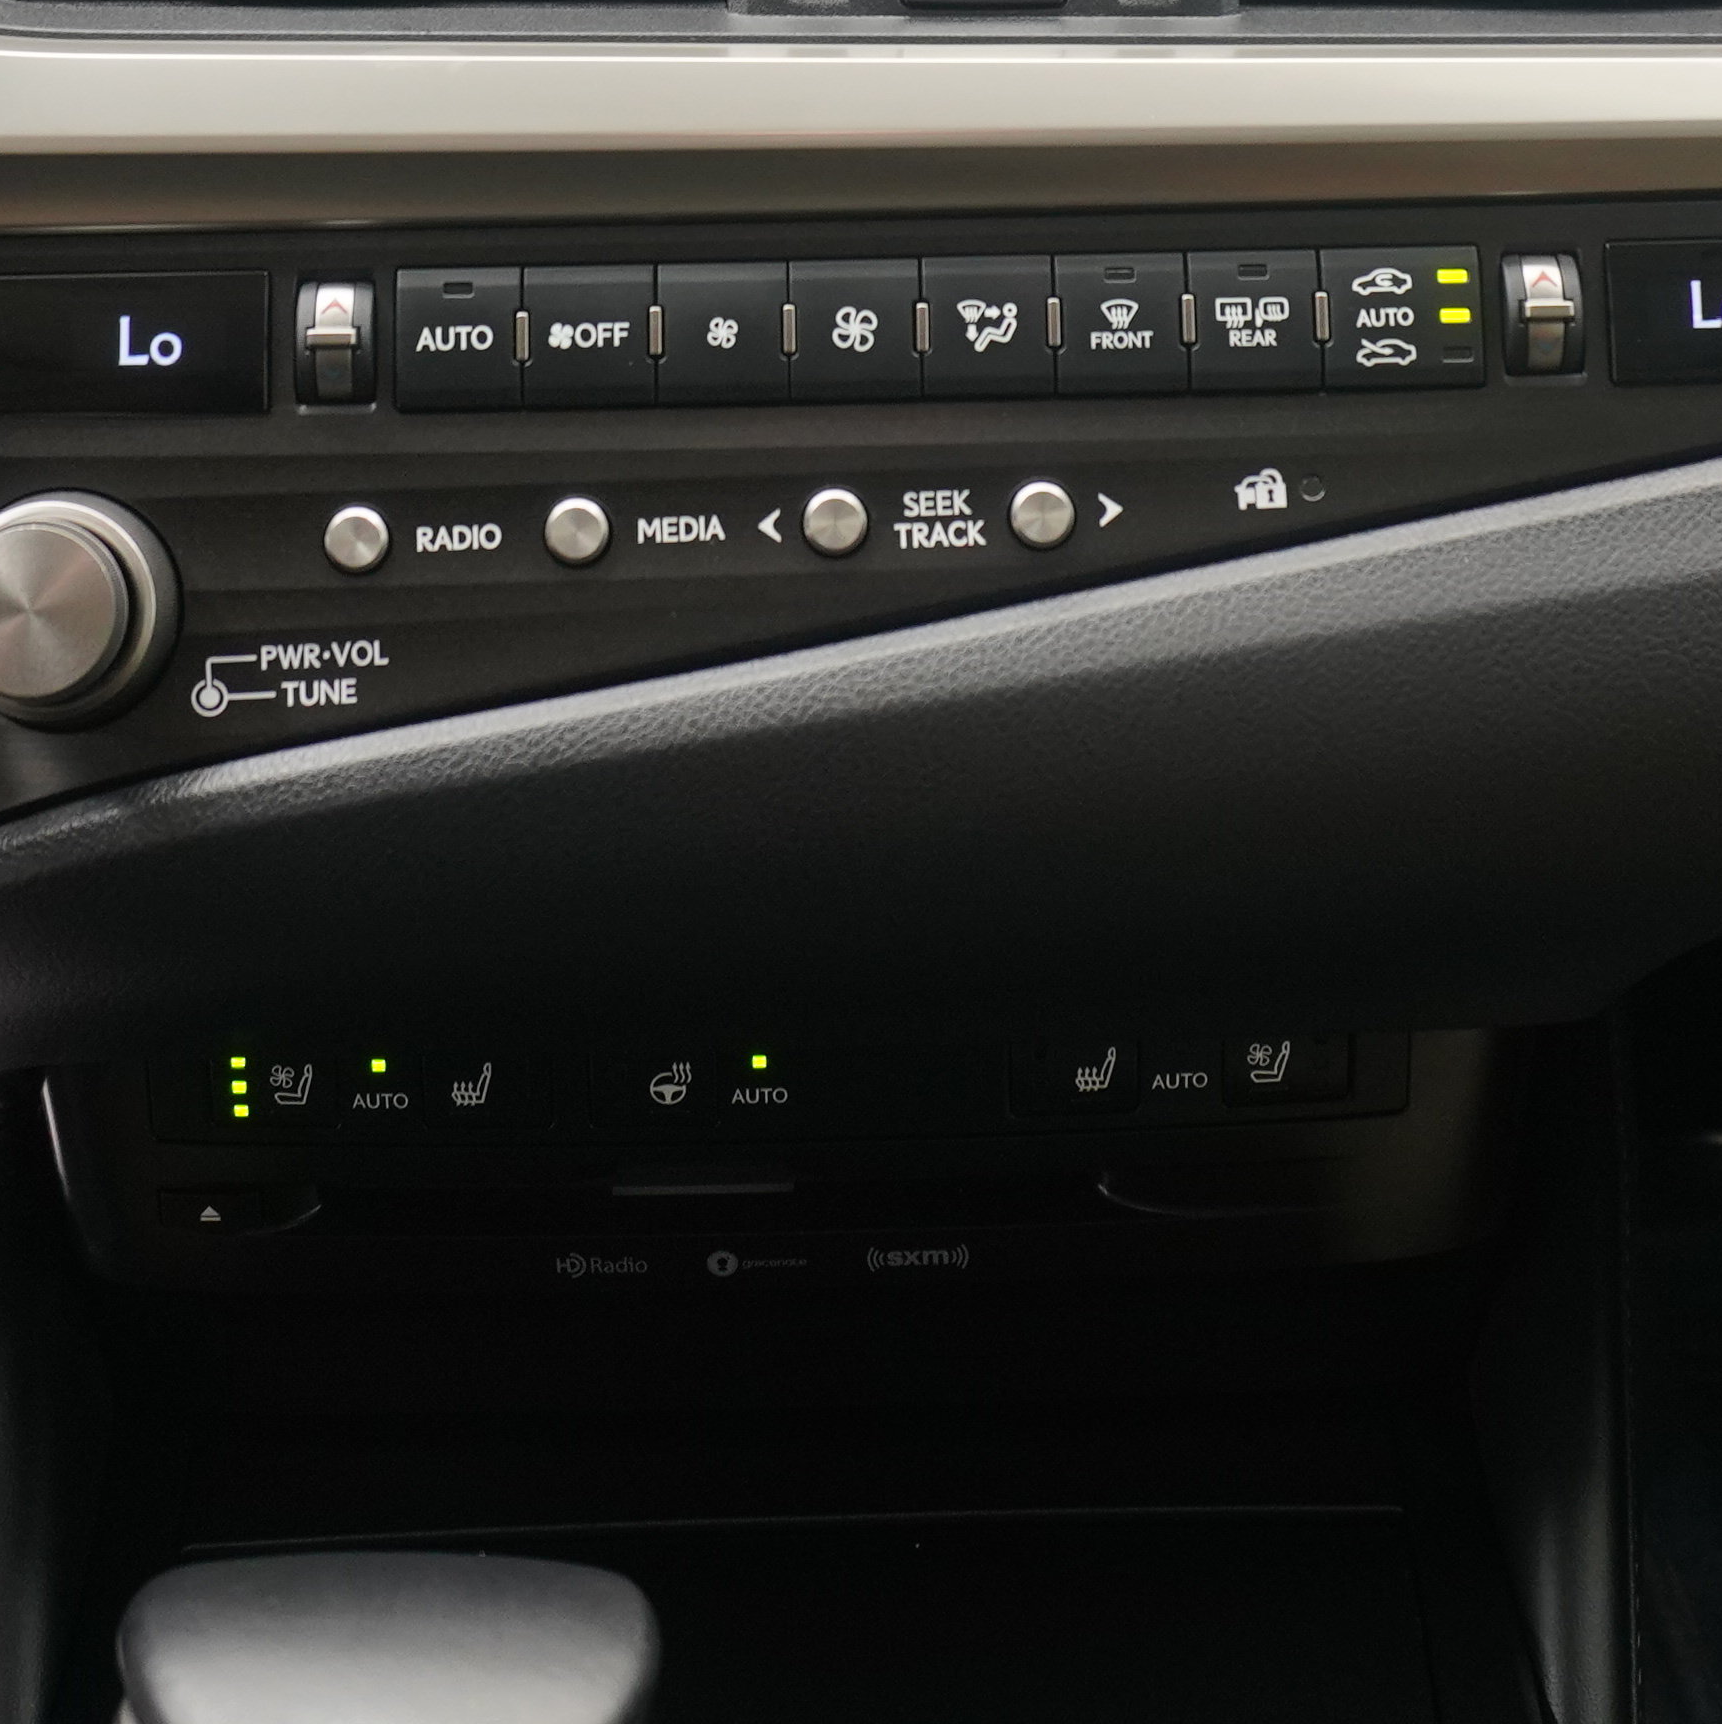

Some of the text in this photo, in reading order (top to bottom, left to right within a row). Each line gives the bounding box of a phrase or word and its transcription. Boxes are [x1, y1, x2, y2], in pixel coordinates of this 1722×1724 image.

[1357, 307, 1414, 327] AUTO
[119, 315, 182, 366] Lo
[416, 325, 493, 351] AUTO
[575, 322, 629, 347] OFF
[1090, 329, 1153, 351] FRONT
[1227, 329, 1277, 348] REAR
[903, 490, 971, 517] SEEK
[417, 523, 502, 552] RADIO
[638, 515, 725, 544] MEDIA
[894, 520, 986, 549] TRACK
[281, 678, 357, 707] TUNE
[1152, 1072, 1208, 1089] AUTO
[353, 1093, 408, 1109] AUTO
[732, 1088, 788, 1103] AUTO
[590, 1257, 648, 1273] Radio
